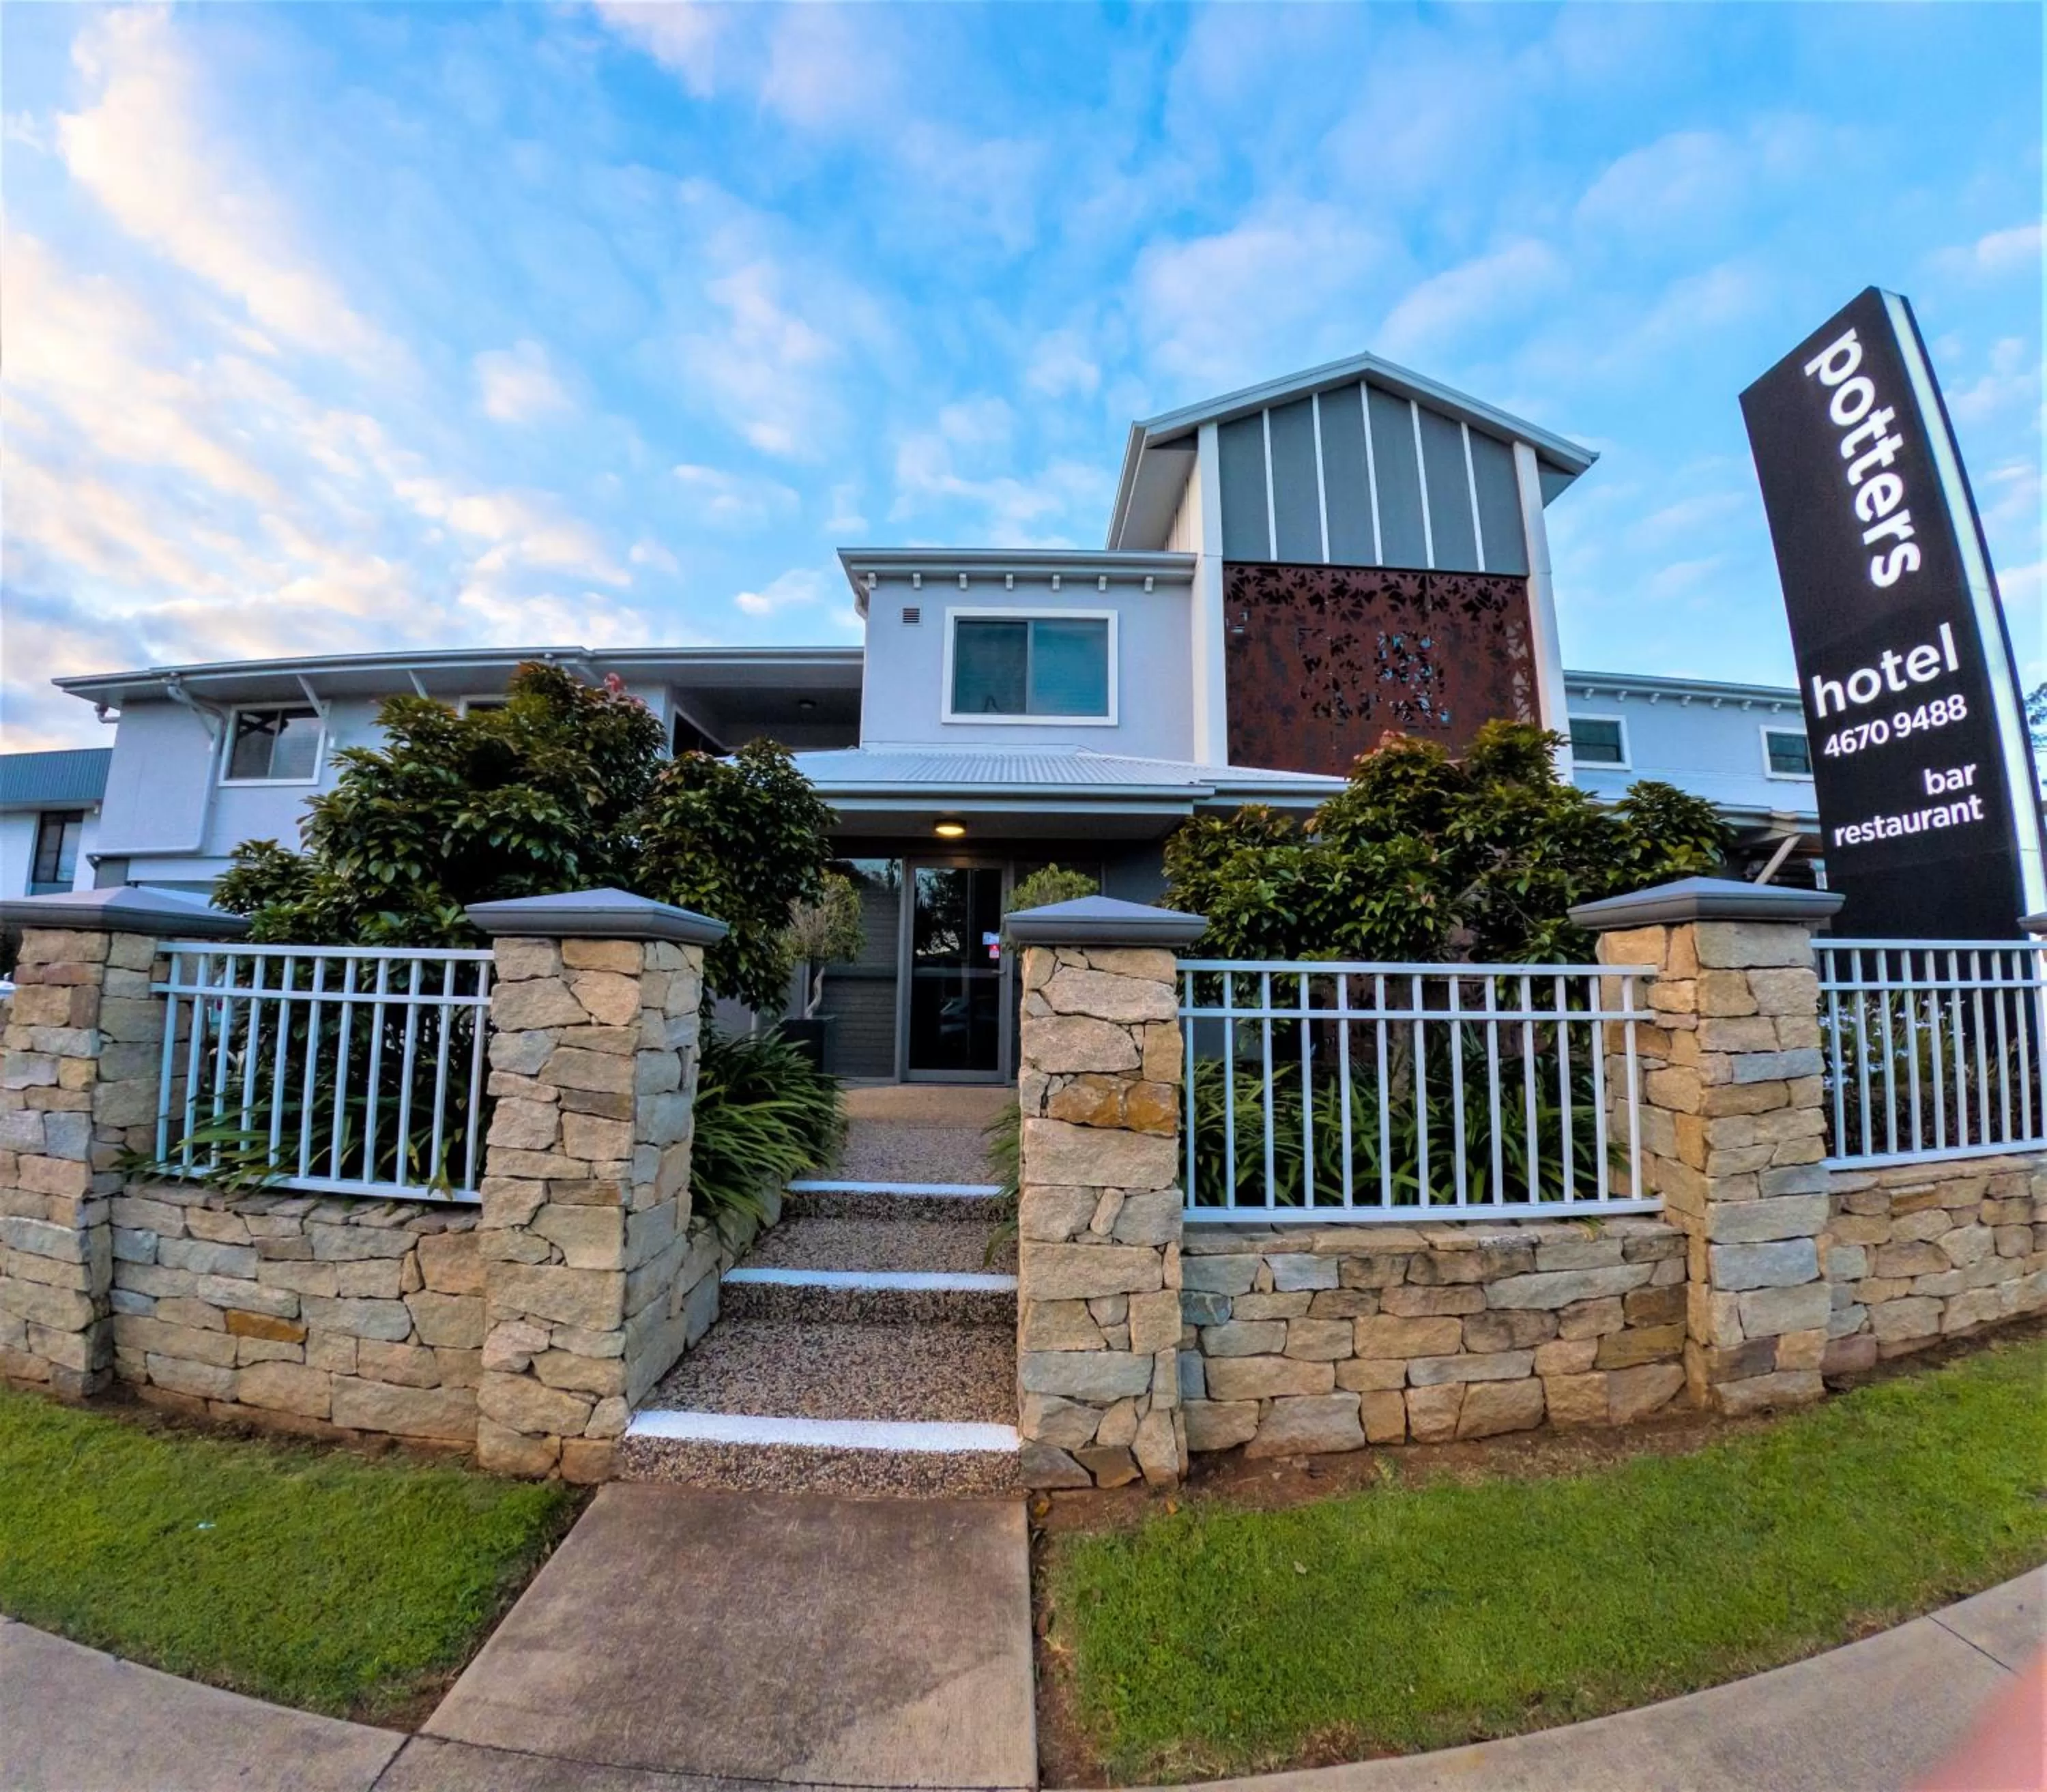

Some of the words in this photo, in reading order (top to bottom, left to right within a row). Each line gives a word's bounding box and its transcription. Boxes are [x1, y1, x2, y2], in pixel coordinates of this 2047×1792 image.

[1803, 327, 1921, 588] potters
[1812, 622, 1960, 719] hotel
[1824, 719, 1889, 757] 4670
[1893, 694, 1967, 738] 9488
[1923, 764, 1977, 795] bar
[1834, 794, 1984, 846] restaurant
